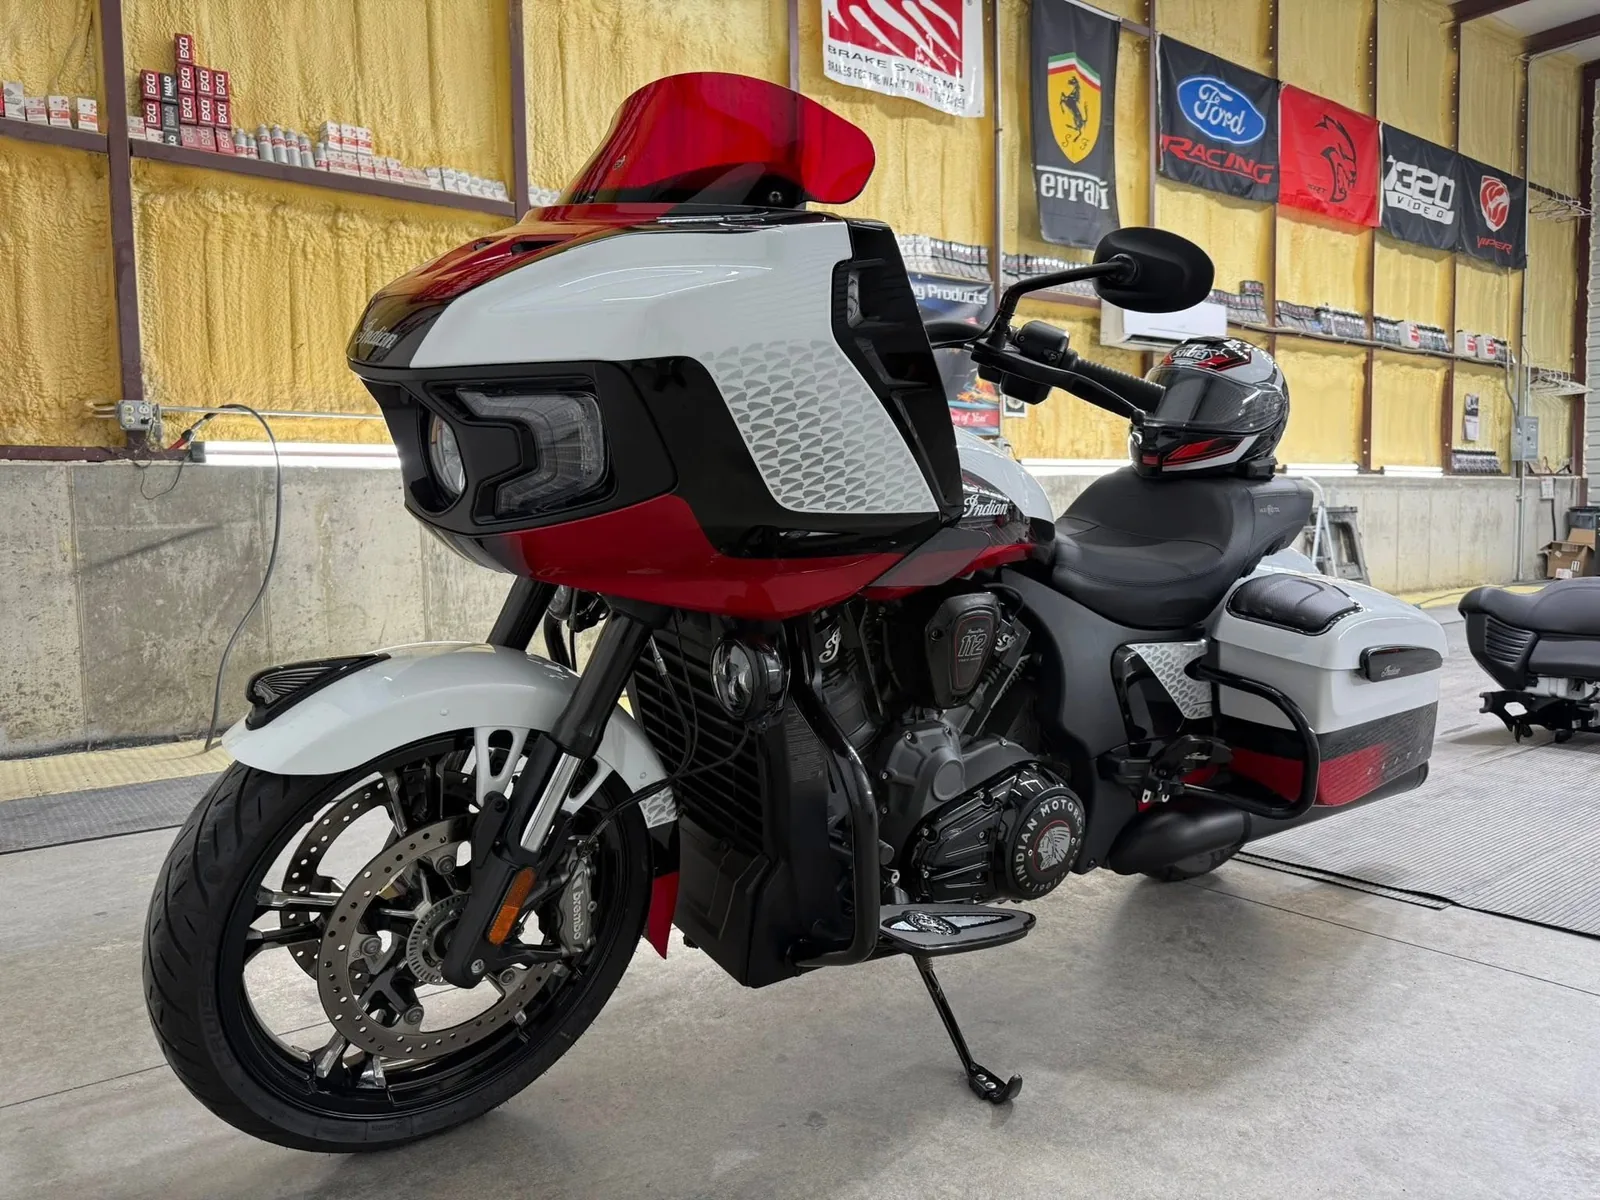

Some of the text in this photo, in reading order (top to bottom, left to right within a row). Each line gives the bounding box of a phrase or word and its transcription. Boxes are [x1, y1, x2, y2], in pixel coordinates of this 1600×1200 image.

[180, 37, 189, 59] EXO
[181, 67, 191, 89] EXO
[828, 44, 965, 92] BRAKE SYSTEMS
[146, 73, 156, 94] EXO
[164, 75, 175, 97] HALO
[200, 70, 210, 92] EXO
[216, 73, 226, 95] EXO
[147, 103, 157, 124] EXO
[182, 97, 192, 119] EXO
[201, 99, 211, 121] EXO
[217, 102, 227, 124] EXO
[1194, 84, 1247, 135] Ford
[1162, 135, 1275, 184] RACING
[1384, 154, 1455, 210] 1320
[1397, 195, 1445, 219] VIDEO
[1476, 235, 1513, 255] VIPER
[927, 284, 989, 305] Products
[962, 493, 1009, 518] Indian
[957, 632, 988, 657] 112
[1015, 817, 1039, 882] INDIAN
[572, 889, 584, 940] brembo
